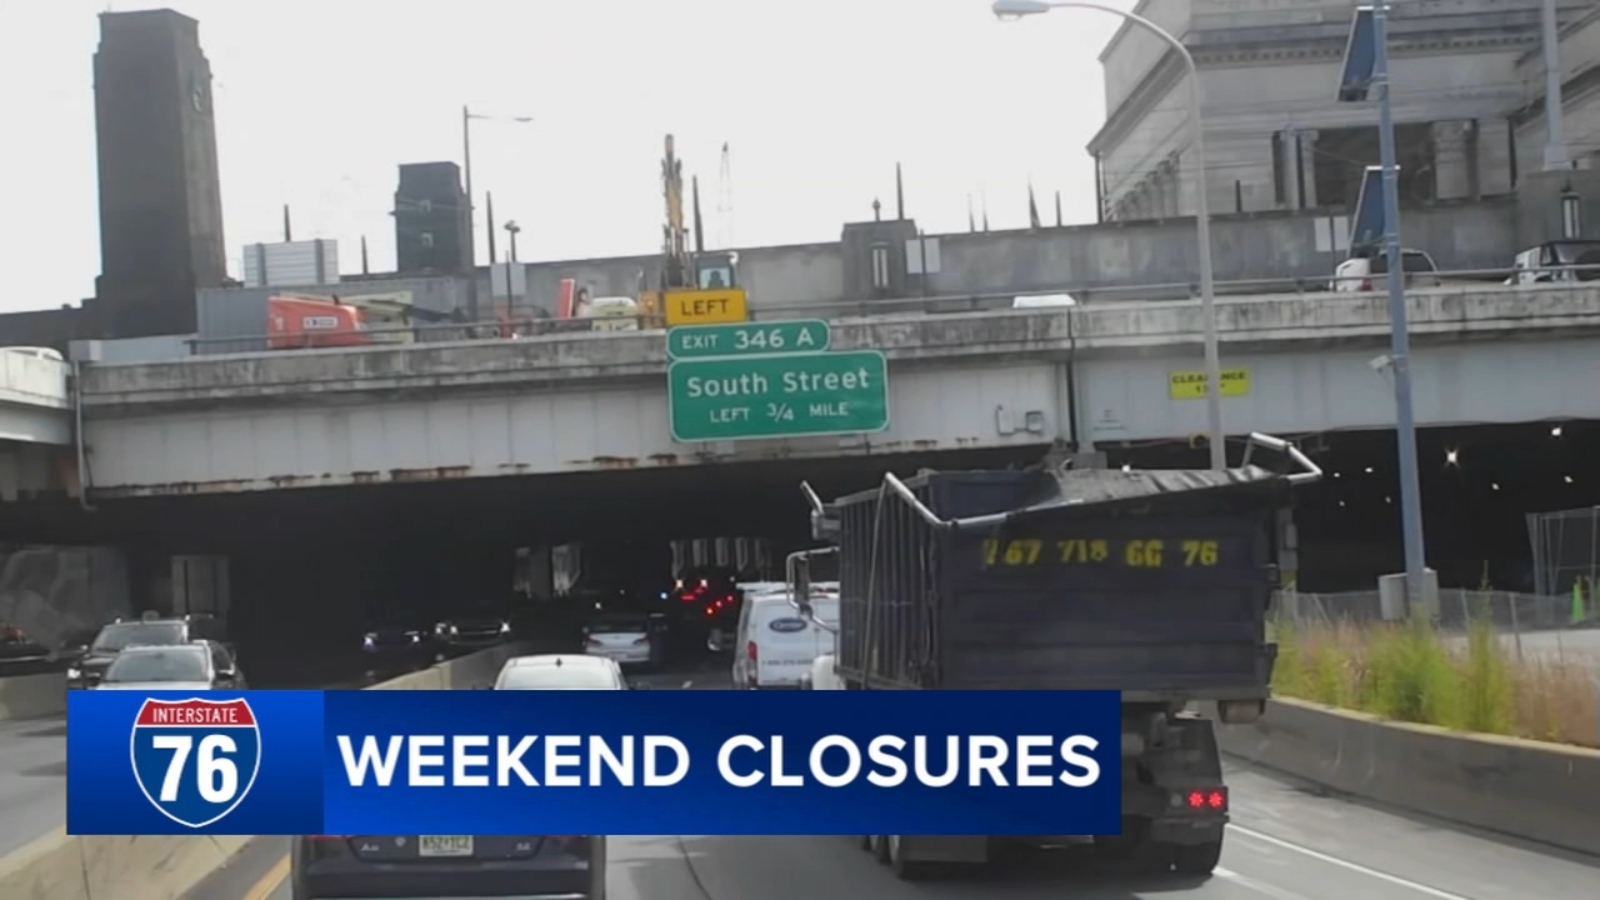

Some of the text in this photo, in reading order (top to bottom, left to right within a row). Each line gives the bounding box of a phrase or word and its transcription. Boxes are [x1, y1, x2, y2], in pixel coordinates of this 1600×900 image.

[681, 299, 730, 316] LEFT
[681, 327, 815, 350] EXIT 346 A
[687, 367, 870, 398] South Street
[1172, 371, 1246, 385] CLEANCE
[709, 407, 750, 424] LEFT
[809, 402, 849, 417] MILE
[1182, 540, 1219, 567] 76
